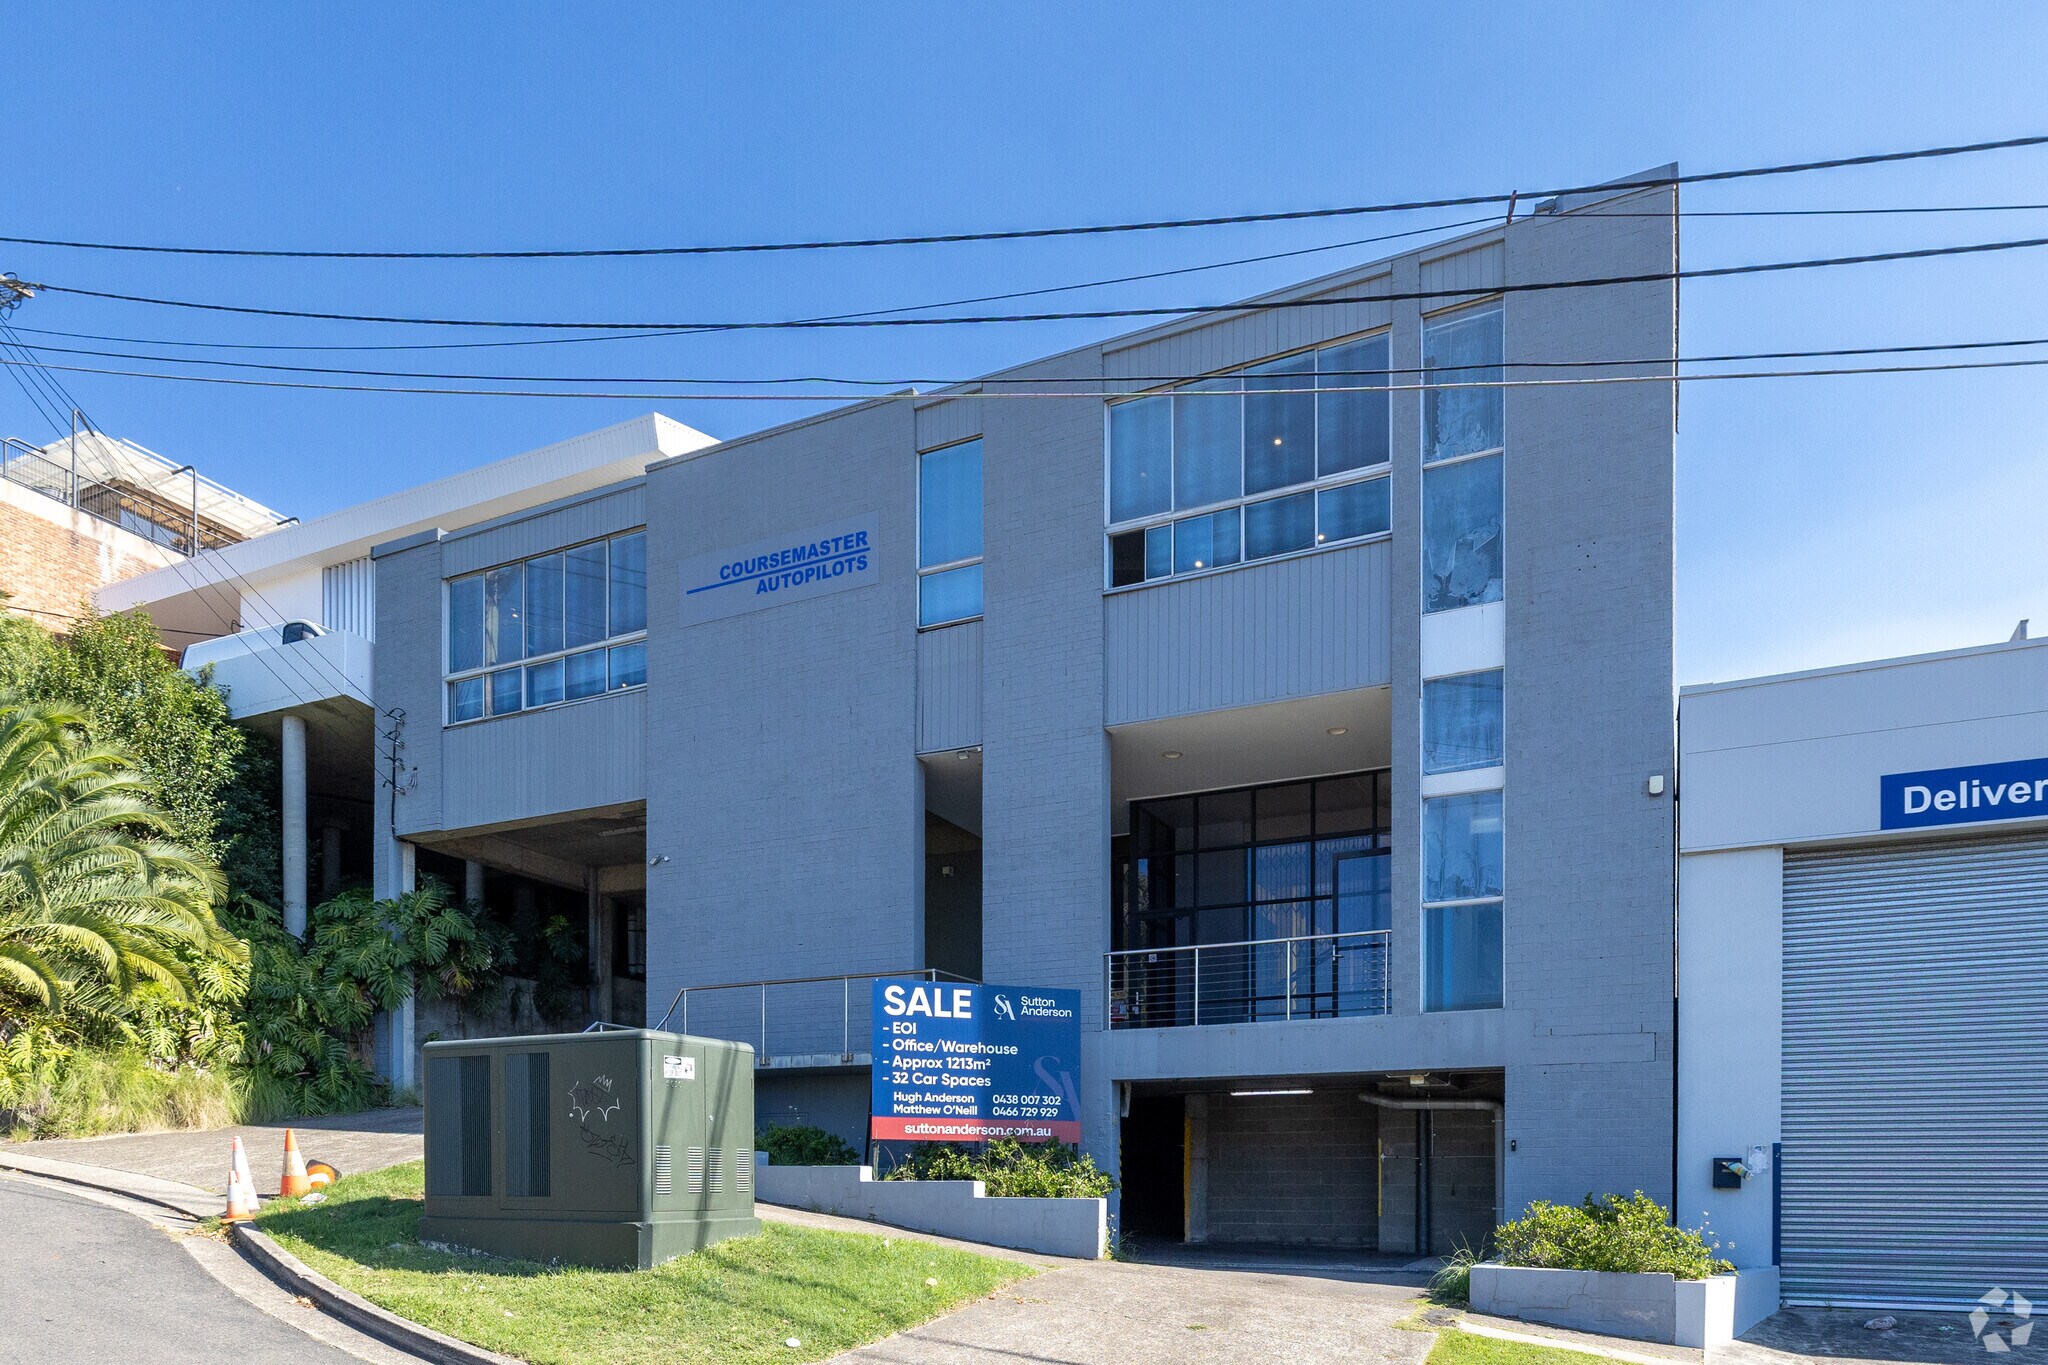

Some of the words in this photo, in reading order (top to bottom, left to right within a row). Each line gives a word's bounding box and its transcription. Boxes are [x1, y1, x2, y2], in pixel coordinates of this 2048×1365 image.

[719, 530, 868, 581] COURSEMASTER
[756, 554, 868, 595] AUTOPILOTS
[884, 985, 972, 1019] SALE
[1020, 995, 1056, 1008] Sutton
[1020, 1006, 1073, 1018] Anderson
[892, 1021, 917, 1035] EOI
[892, 1038, 1019, 1056] Office/Warehouse
[892, 1055, 943, 1071] Approx
[892, 1071, 909, 1084] 32
[912, 1072, 938, 1085] Car
[941, 1073, 992, 1089] Spaces
[893, 1091, 922, 1106] Hugh
[924, 1092, 975, 1104] Anderson
[992, 1094, 1019, 1105] 0438
[1020, 1095, 1040, 1105] 007
[1042, 1095, 1062, 1106] 302
[893, 1104, 942, 1115] Matthew
[992, 1106, 1019, 1117] 0466
[1020, 1107, 1039, 1117] 729
[1040, 1107, 1059, 1118] 929
[904, 1122, 1052, 1137] suttonanderson.com.au
